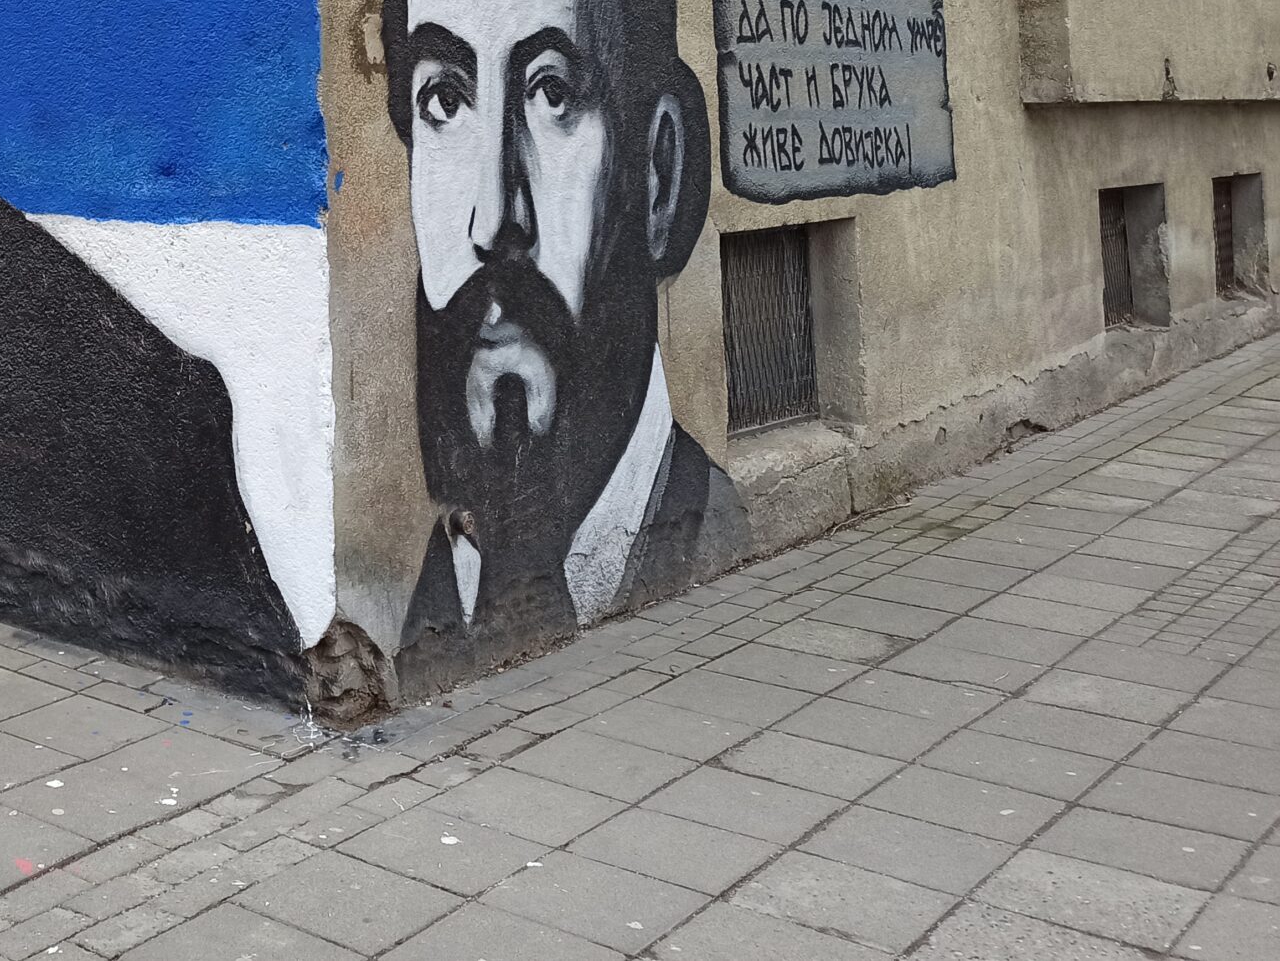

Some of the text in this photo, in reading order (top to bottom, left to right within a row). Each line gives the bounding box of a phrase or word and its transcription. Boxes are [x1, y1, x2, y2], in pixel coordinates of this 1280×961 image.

[738, 61, 793, 113] ЧАСТ
[831, 63, 893, 110] БРУКА
[742, 122, 805, 172] ЖИВЕ
